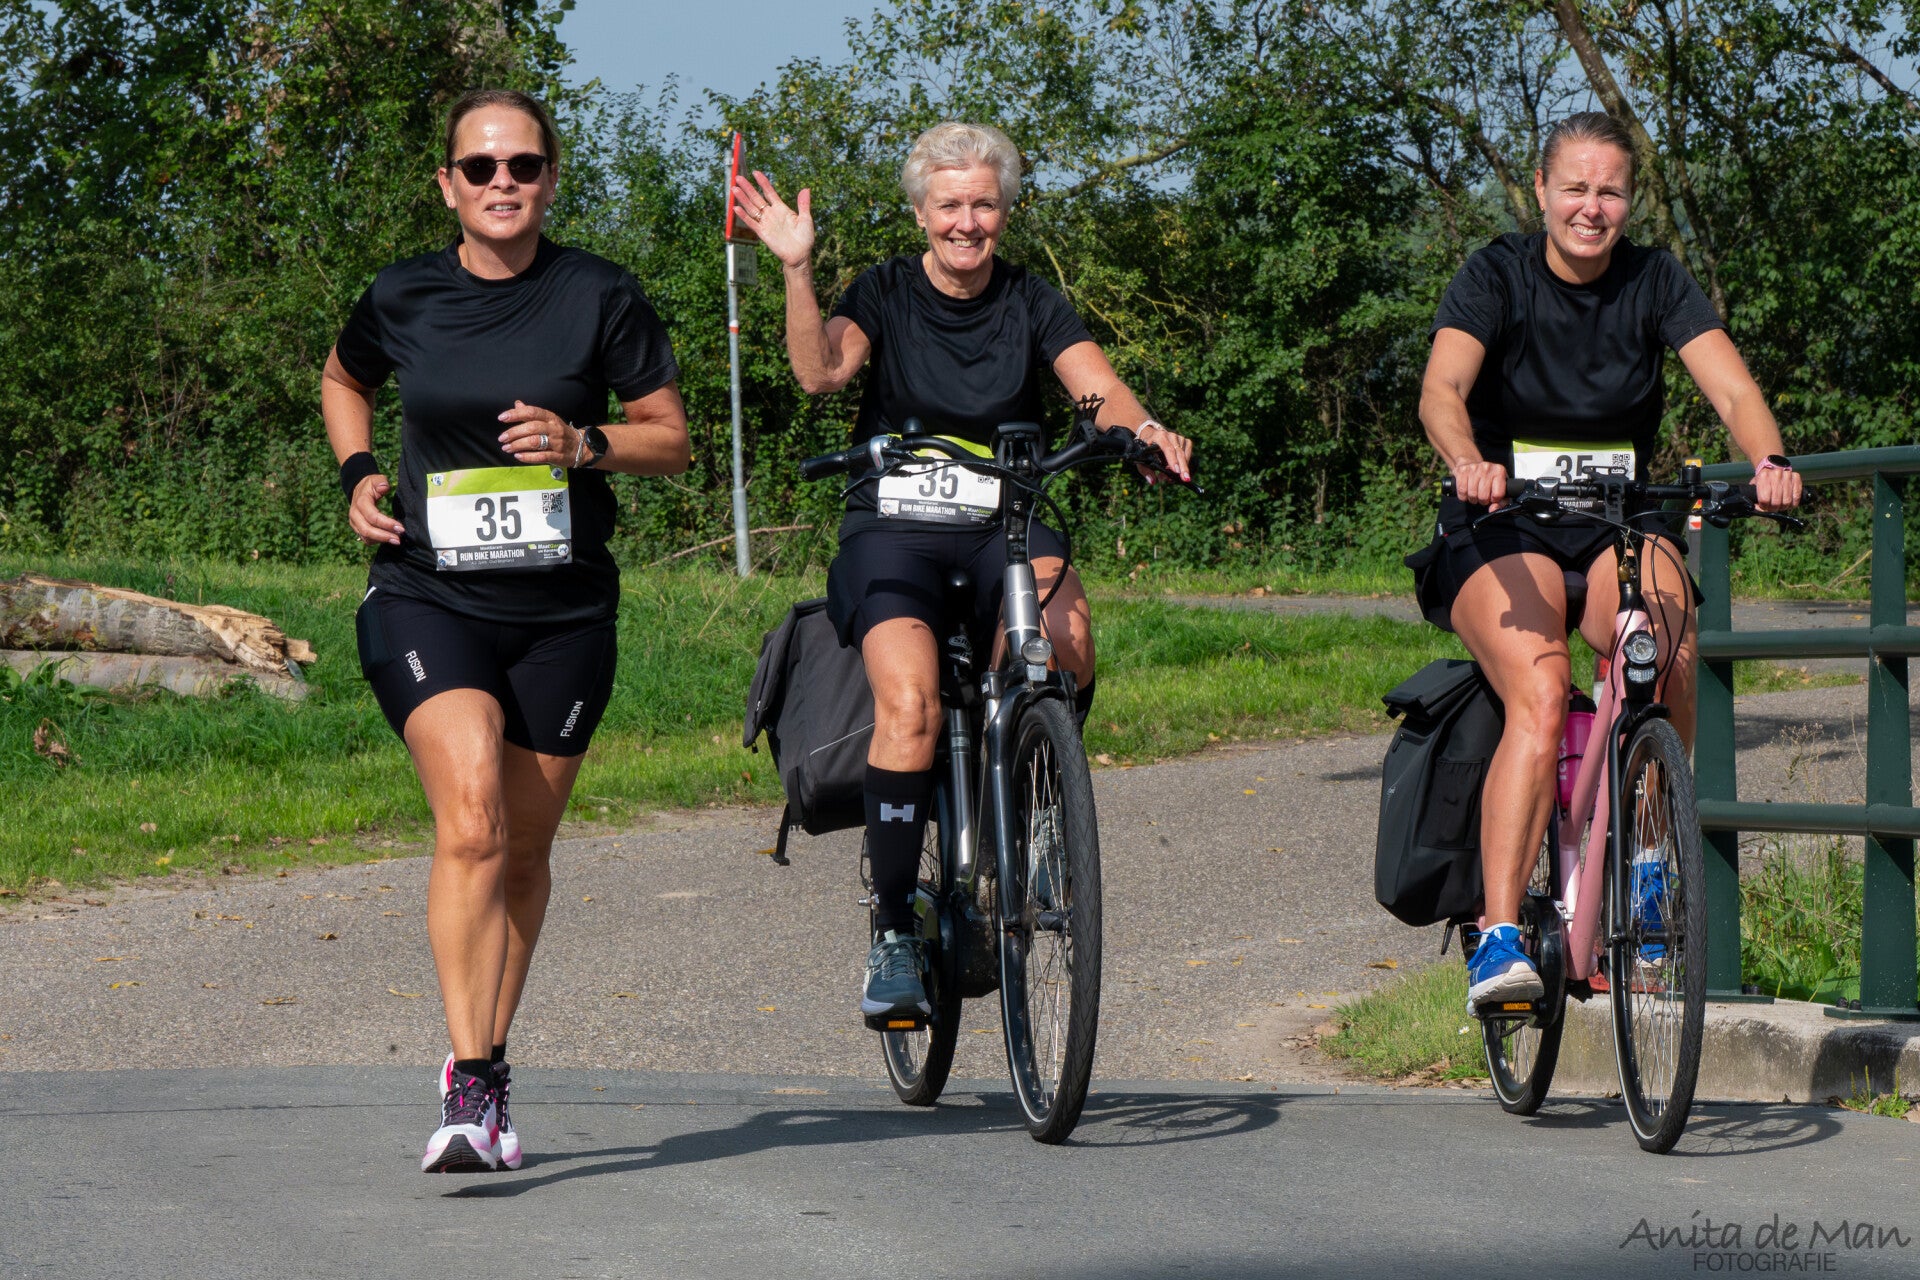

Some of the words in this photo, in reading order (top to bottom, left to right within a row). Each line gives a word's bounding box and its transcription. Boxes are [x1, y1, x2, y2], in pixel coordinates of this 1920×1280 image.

[918, 461, 959, 499] 35
[474, 495, 522, 542] 35
[900, 503, 913, 512] RUN
[912, 504, 926, 513] BIKE
[925, 505, 956, 516] MARATHON
[1563, 500, 1593, 508] MARATHON
[460, 551, 474, 561] RUN
[474, 550, 489, 560] BIKE
[489, 548, 525, 559] MARATHON
[405, 650, 427, 682] FUSION
[560, 701, 584, 737] FUSION
